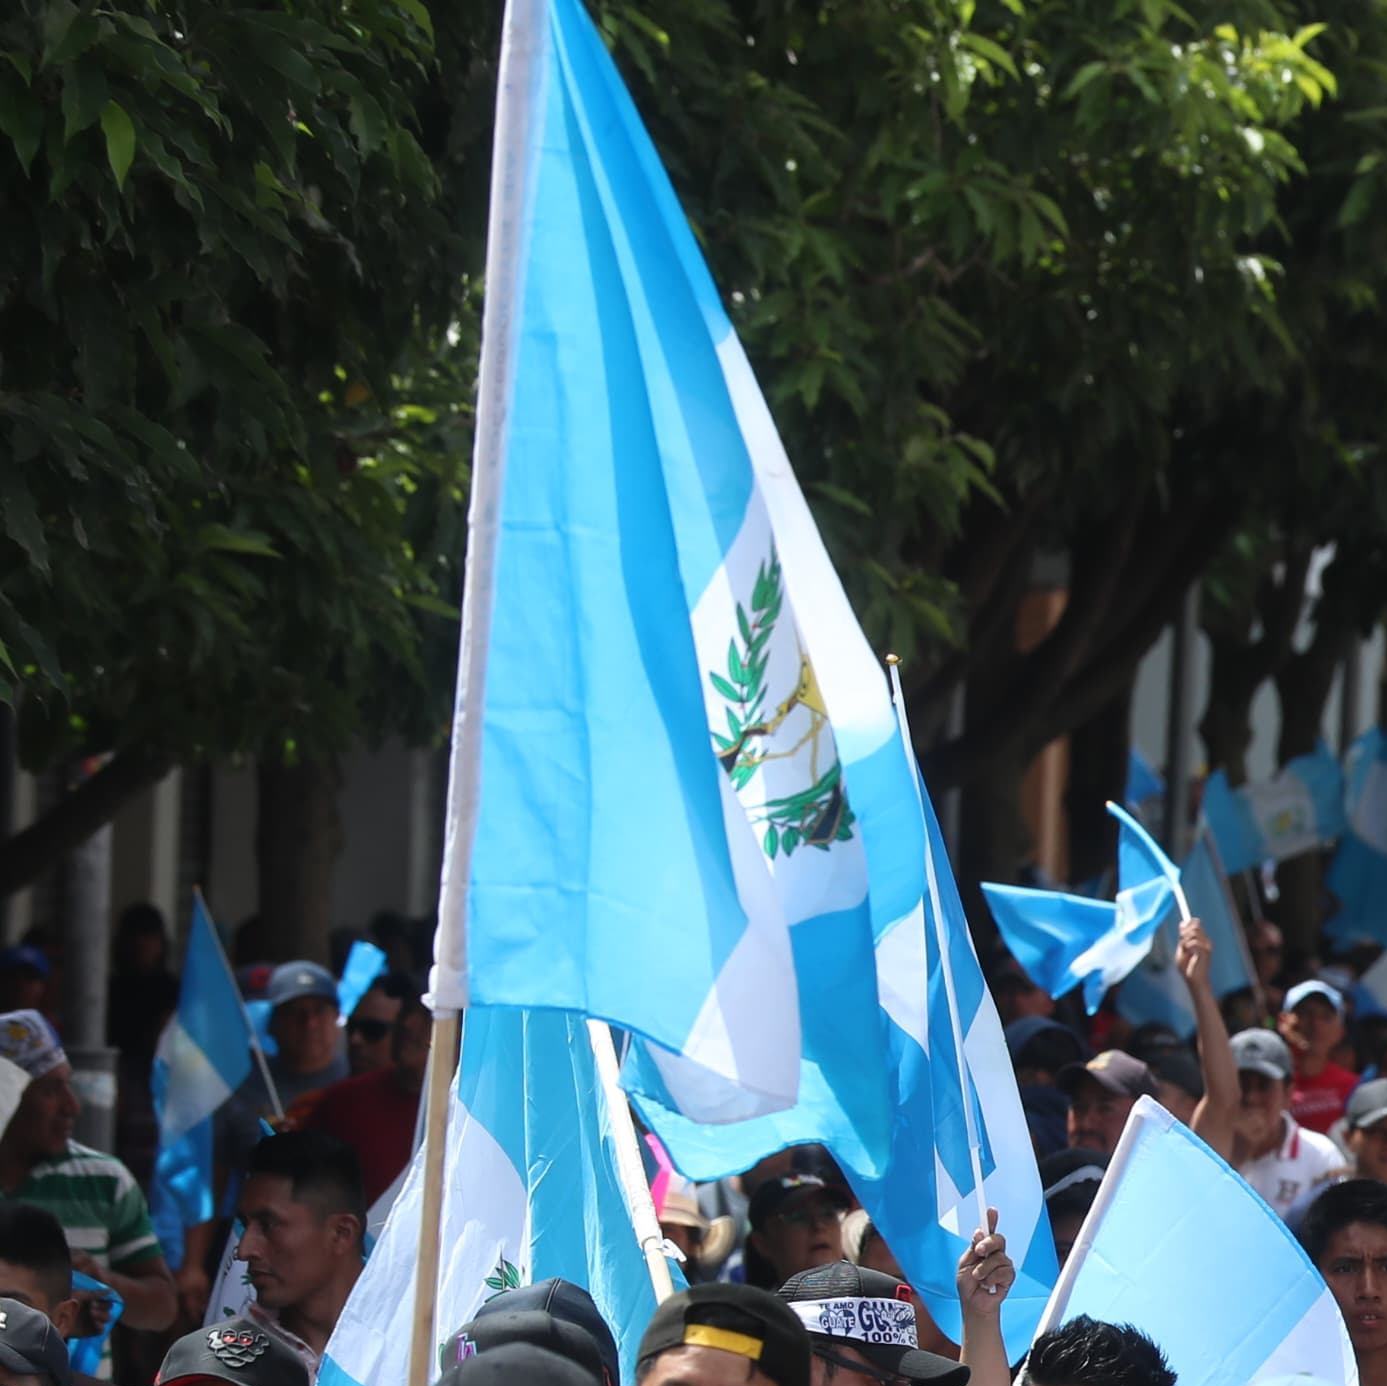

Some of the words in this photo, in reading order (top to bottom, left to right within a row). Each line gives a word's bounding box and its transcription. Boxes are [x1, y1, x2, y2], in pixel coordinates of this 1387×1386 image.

[833, 1301, 854, 1310] AMO
[821, 1315, 856, 1329] GUATE
[861, 1331, 906, 1343] 100%
